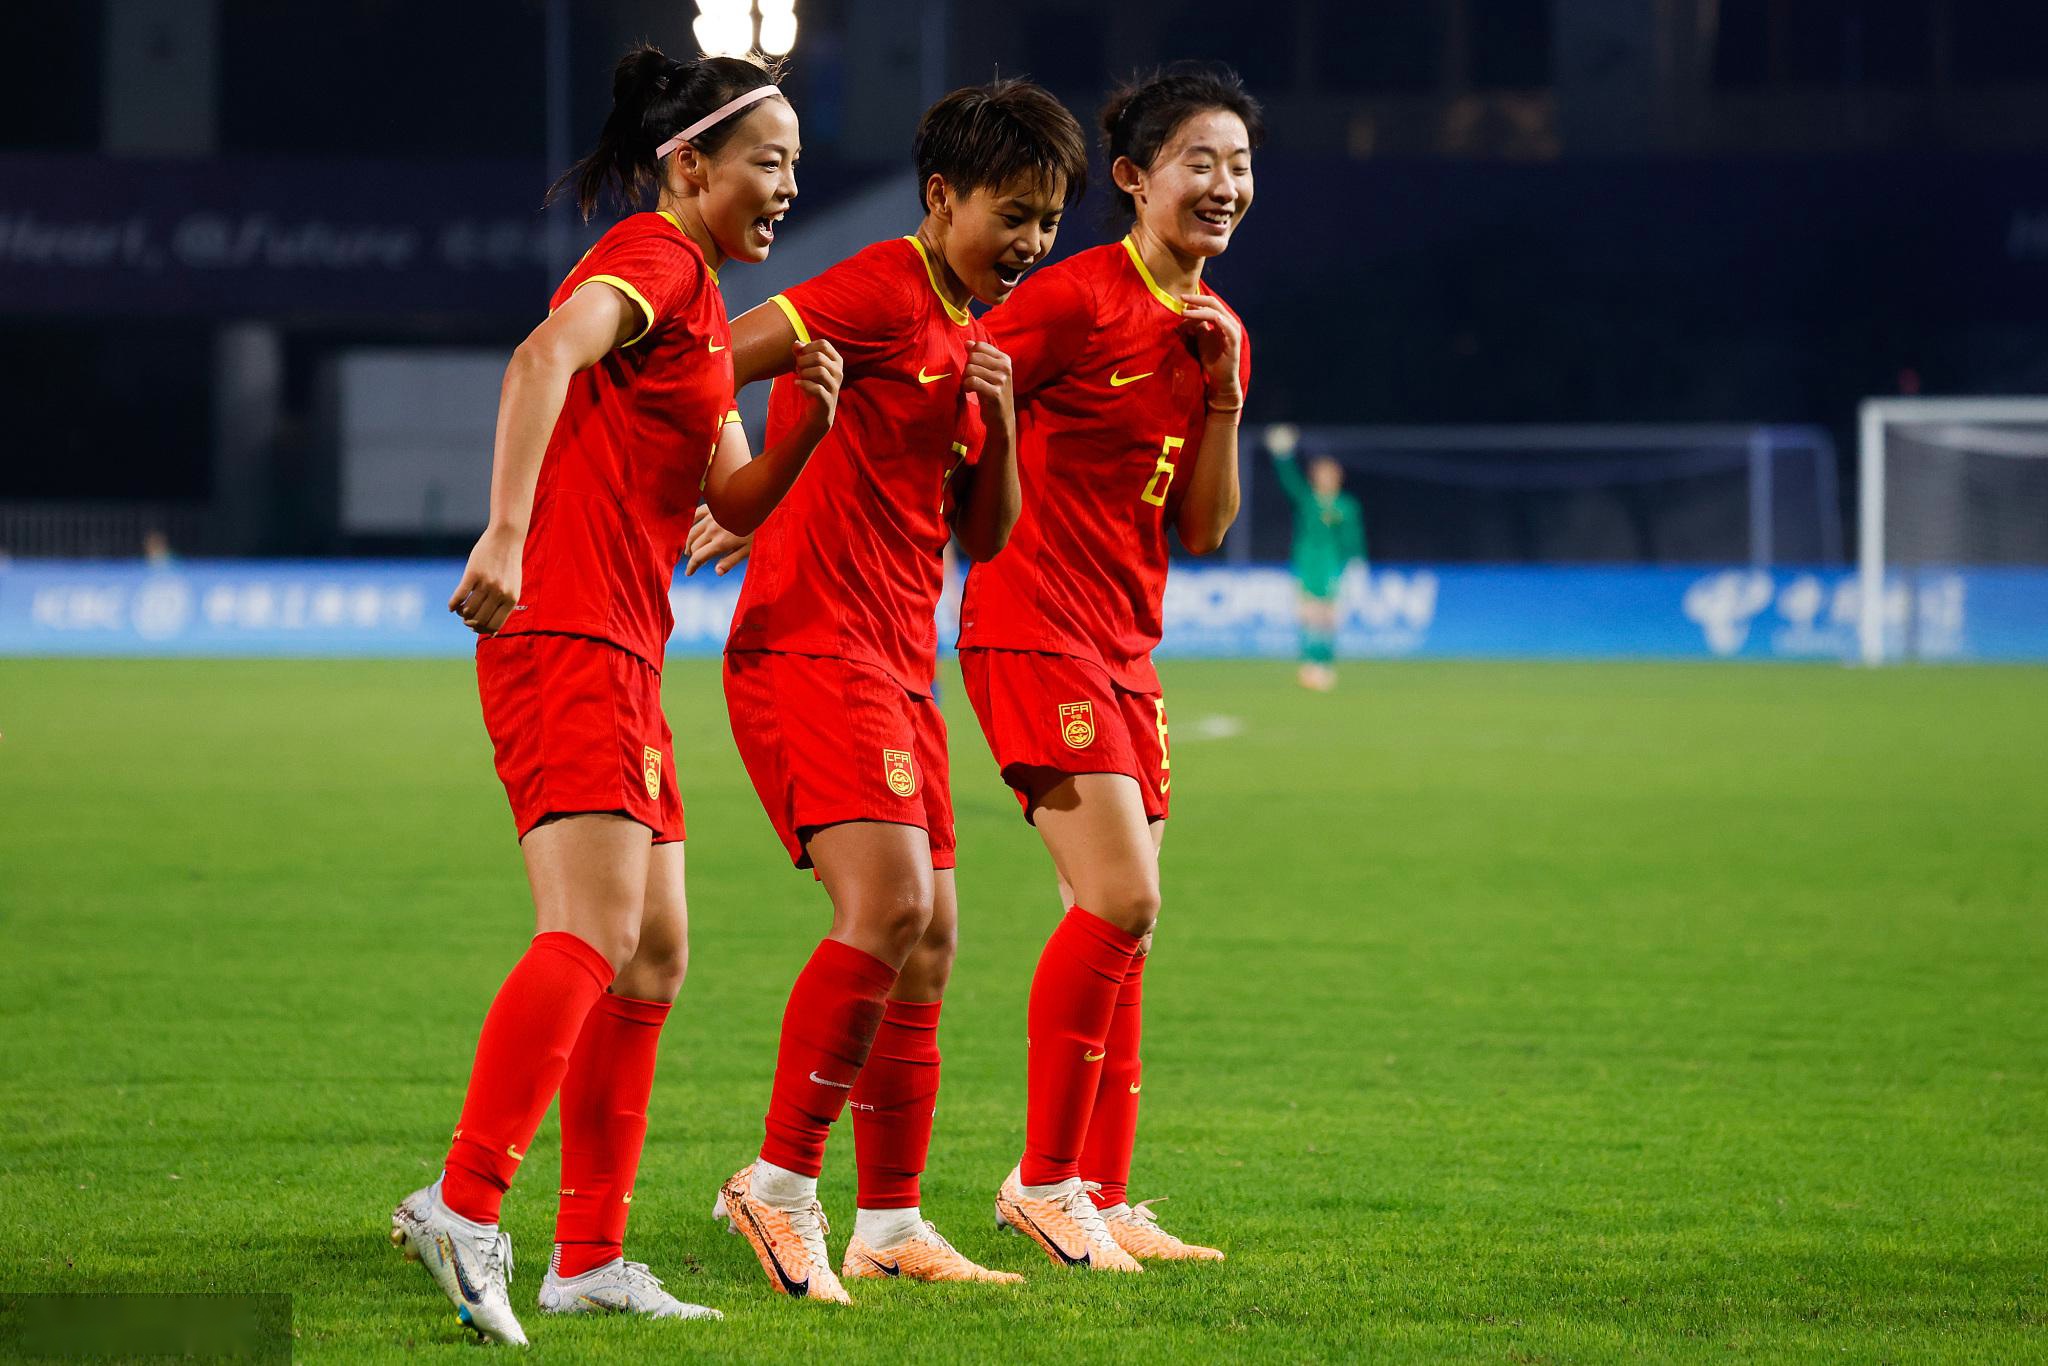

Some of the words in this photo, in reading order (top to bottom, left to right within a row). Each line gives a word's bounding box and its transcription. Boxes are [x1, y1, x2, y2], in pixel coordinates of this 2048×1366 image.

[1141, 435, 1185, 507] 6
[1062, 704, 1089, 716] CFA
[886, 752, 909, 764] CFA
